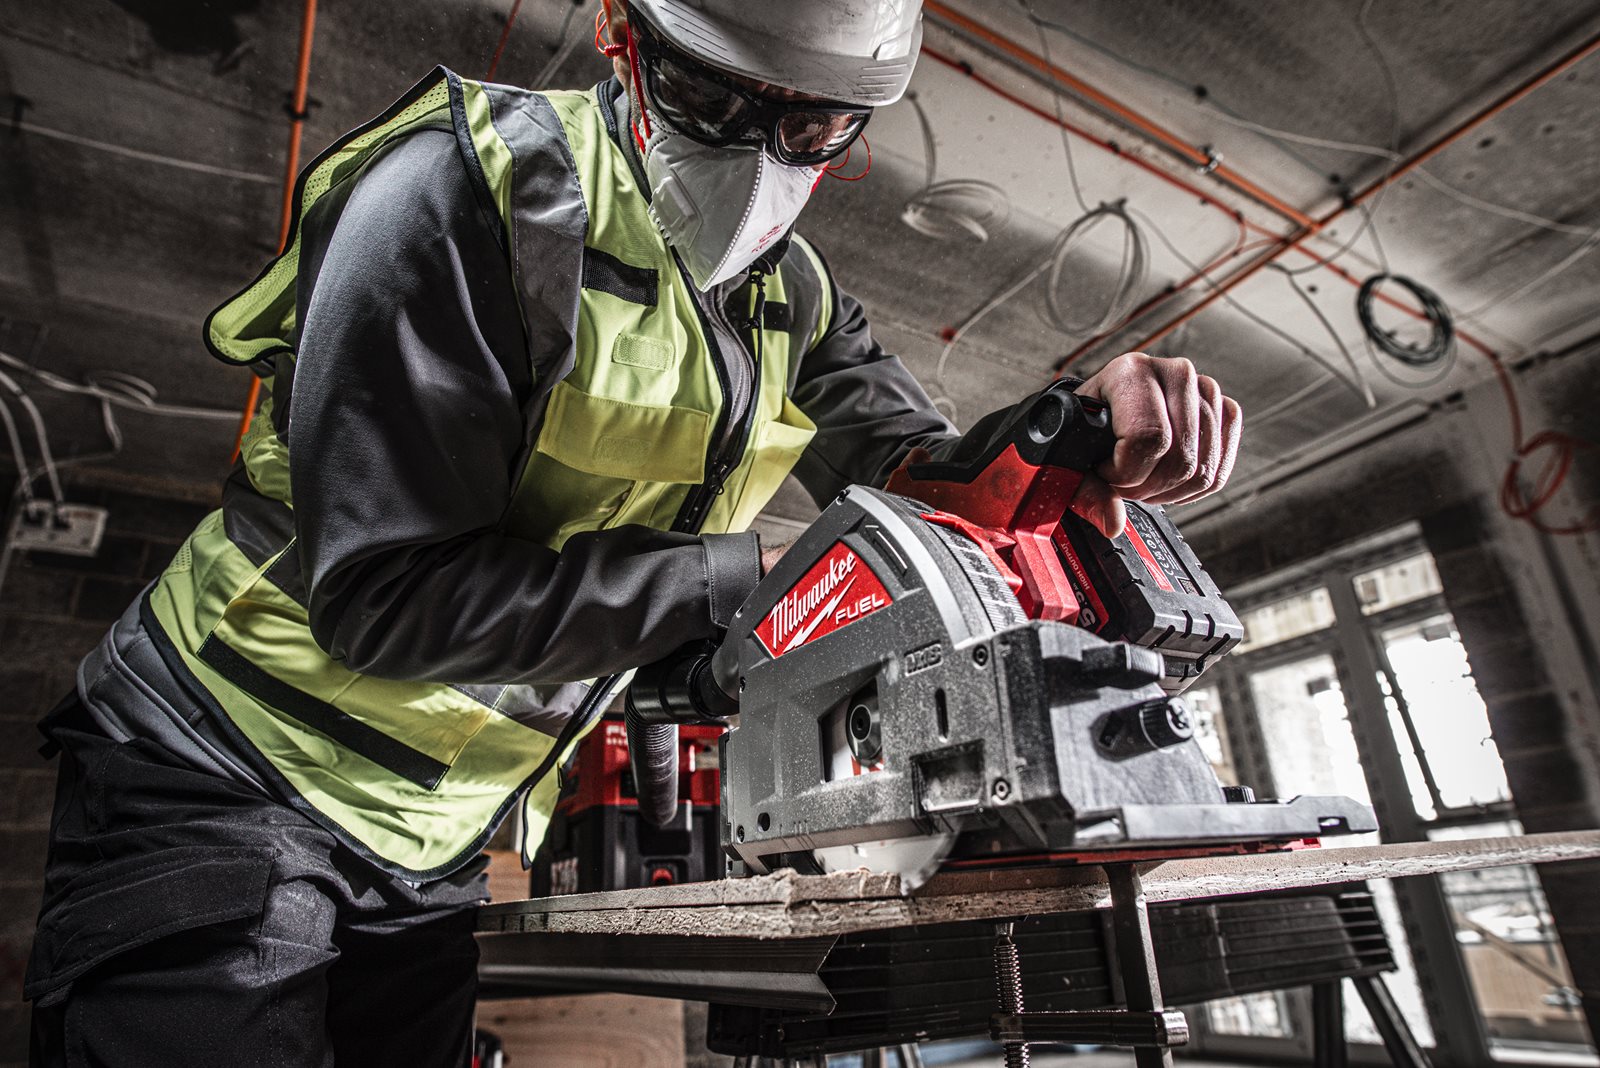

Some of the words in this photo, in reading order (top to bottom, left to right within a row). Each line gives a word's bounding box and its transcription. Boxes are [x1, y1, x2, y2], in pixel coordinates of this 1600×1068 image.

[1061, 543, 1079, 570] OUTPUT
[1077, 571, 1090, 590] HIGH
[768, 552, 857, 650] Milwaukee
[835, 593, 885, 625] FUEL
